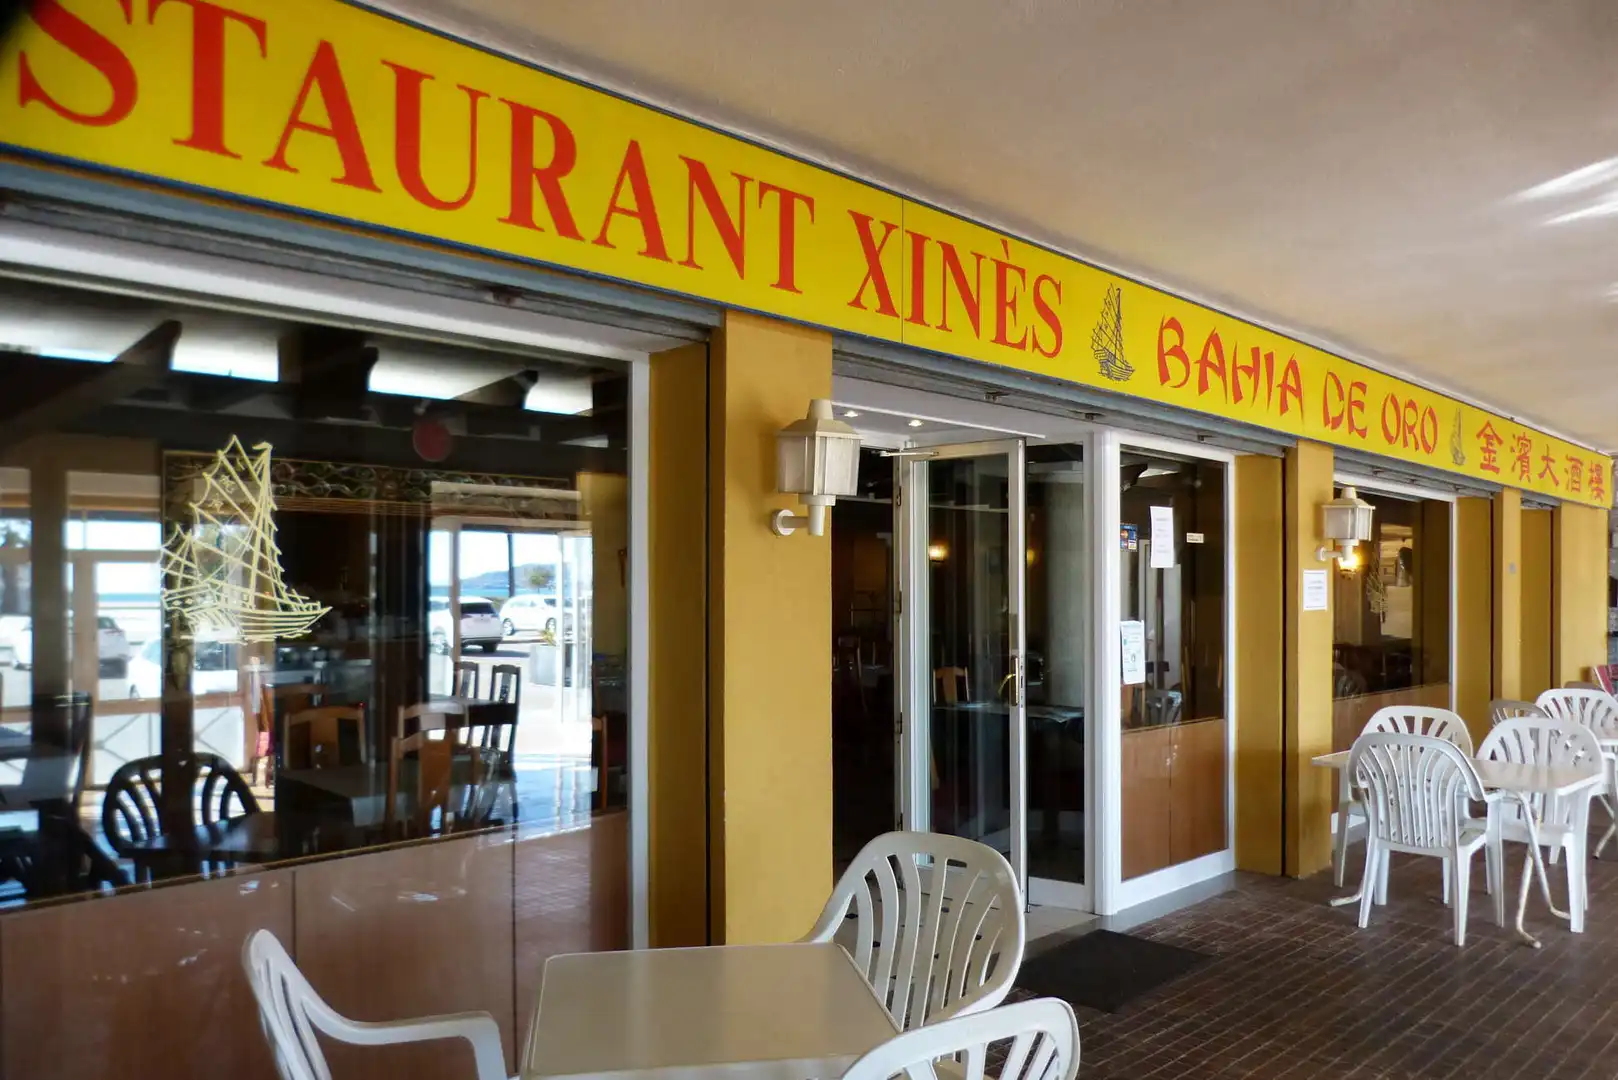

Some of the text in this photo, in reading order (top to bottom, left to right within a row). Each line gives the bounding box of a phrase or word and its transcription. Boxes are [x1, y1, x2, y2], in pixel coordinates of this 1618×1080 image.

[17, 0, 1064, 359] STAURANT XINÈS
[1156, 313, 1439, 454] BAHIA DE ORO
[1476, 420, 1605, 502] 金濱大酒樓
